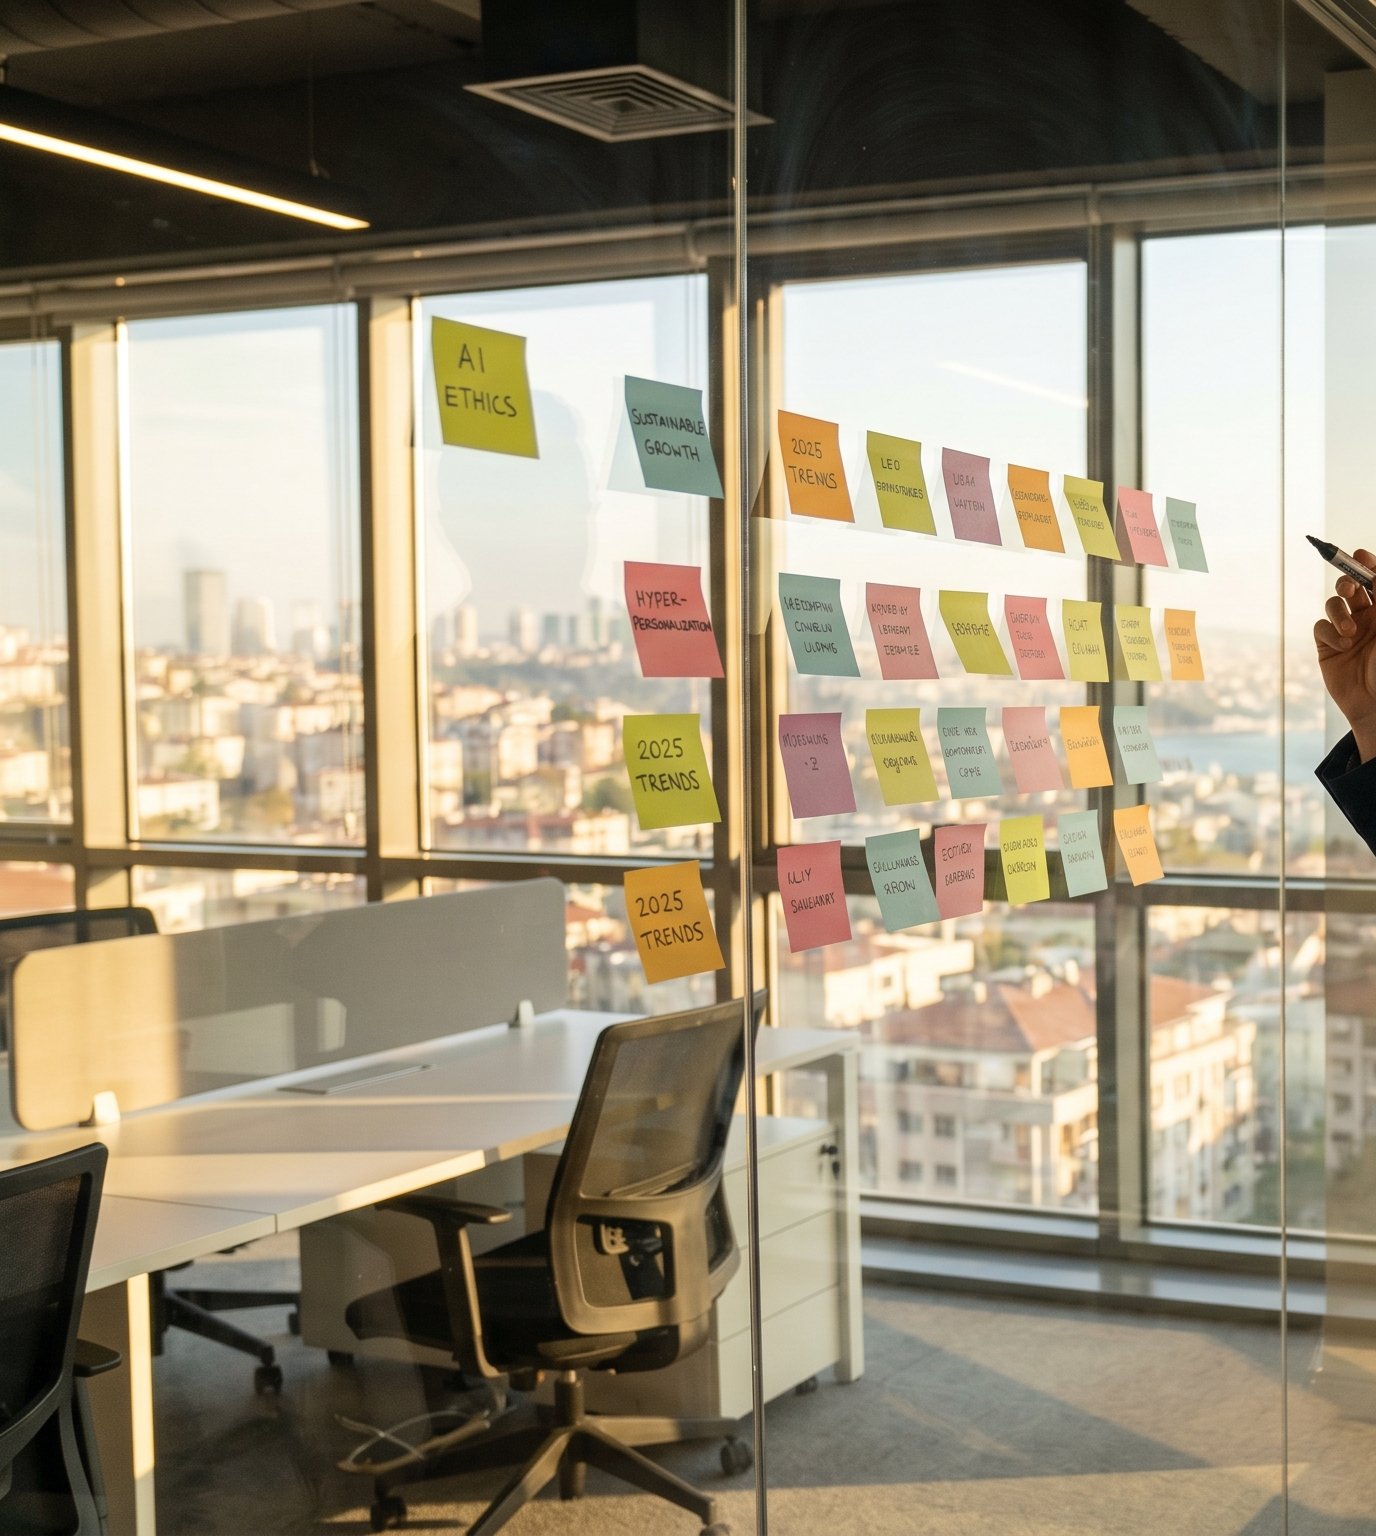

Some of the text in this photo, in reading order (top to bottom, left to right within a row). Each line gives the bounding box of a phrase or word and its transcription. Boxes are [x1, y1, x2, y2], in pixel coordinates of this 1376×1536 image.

[457, 342, 486, 374] AI
[444, 384, 518, 418] ETHICS
[631, 407, 705, 437] SUSTAINABLE
[644, 438, 701, 463] GROWTH
[791, 437, 823, 459] 2025
[635, 589, 688, 609] HYPER-
[631, 614, 713, 633] PERSONALIZATION
[637, 737, 684, 761] 2025
[635, 769, 701, 794] TRENDS
[635, 889, 684, 918] 2025
[640, 921, 705, 951] TRENDS
